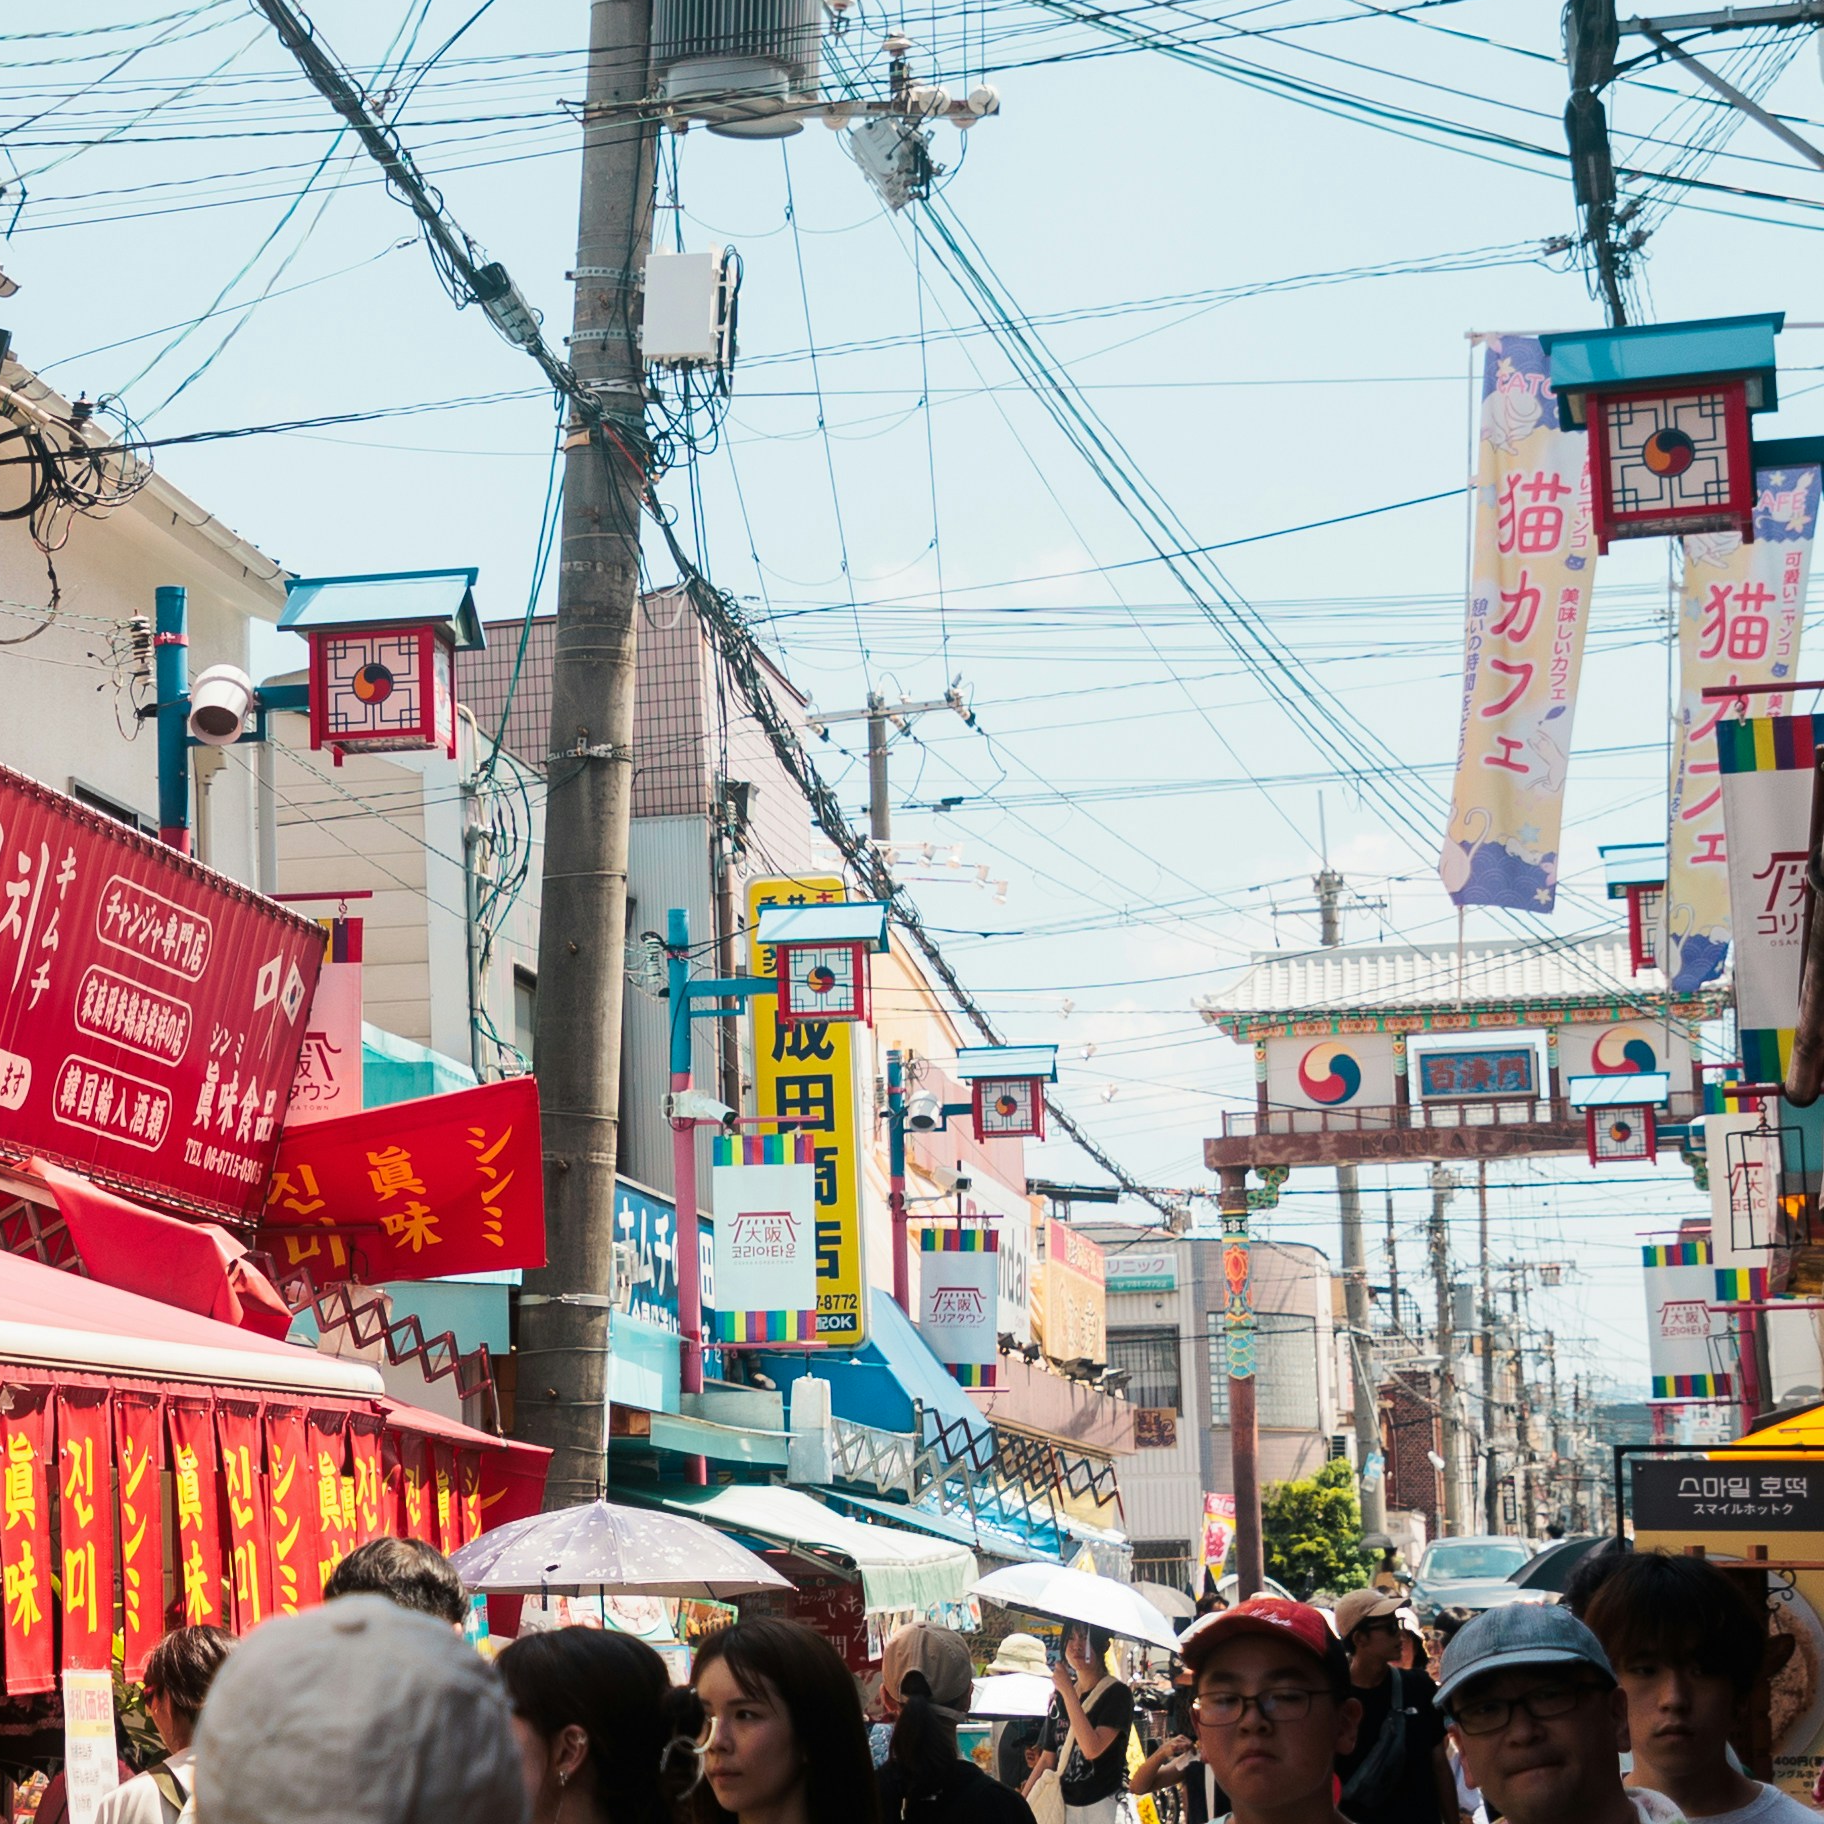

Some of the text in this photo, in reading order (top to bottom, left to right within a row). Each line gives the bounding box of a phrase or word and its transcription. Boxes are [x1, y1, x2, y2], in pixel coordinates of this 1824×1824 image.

[1481, 471, 1572, 773] 猫カフェ
[1777, 551, 1803, 656] 可愛いニャンコ
[1550, 588, 1580, 701] 美味しいカフェ
[28, 846, 77, 1010] キムチ
[104, 889, 207, 972] チャンジャ専門店
[60, 1064, 168, 1142] 韓国輸入酒類
[183, 1138, 202, 1168] TEL
[466, 1124, 515, 1248] シンミ
[732, 1243, 796, 1259] 코리아타운
[744, 1227, 782, 1244] 大阪
[928, 1313, 986, 1324] コリアタウン
[942, 1298, 972, 1312] 大阪
[1670, 1311, 1699, 1324] 大阪
[1677, 1477, 1808, 1499] 스마일 호떡
[1693, 1503, 1794, 1516] スマイルホットク
[64, 1436, 97, 1633] 진미
[121, 1435, 149, 1633] シンミ
[225, 1444, 262, 1625] 진미
